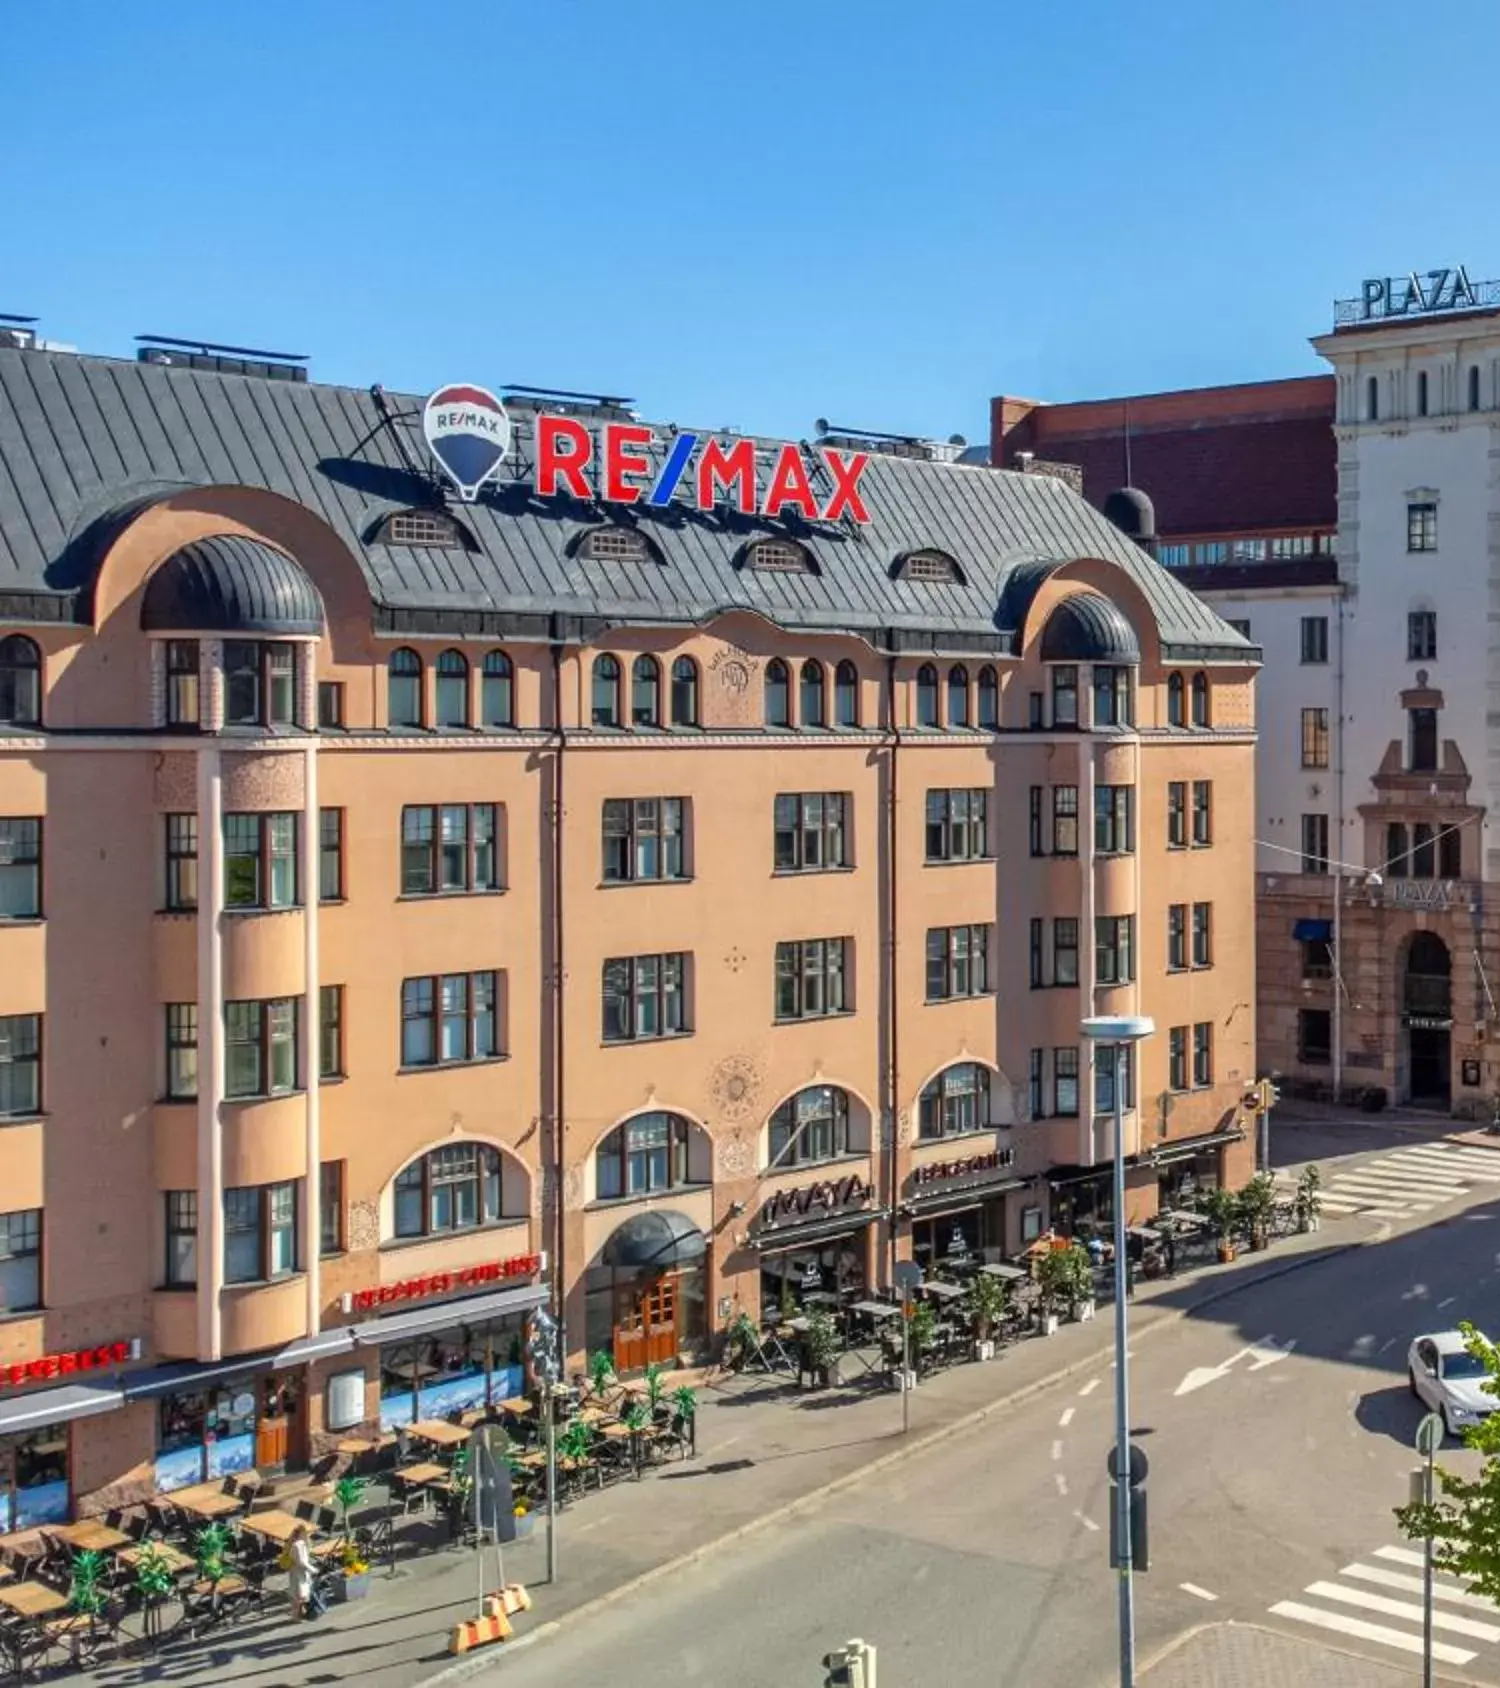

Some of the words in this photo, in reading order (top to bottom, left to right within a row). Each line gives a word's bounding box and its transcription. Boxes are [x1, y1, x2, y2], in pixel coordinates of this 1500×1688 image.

[1362, 265, 1476, 319] PLAZA
[437, 412, 499, 434] RE/MAX
[535, 411, 872, 525] RE/MAX
